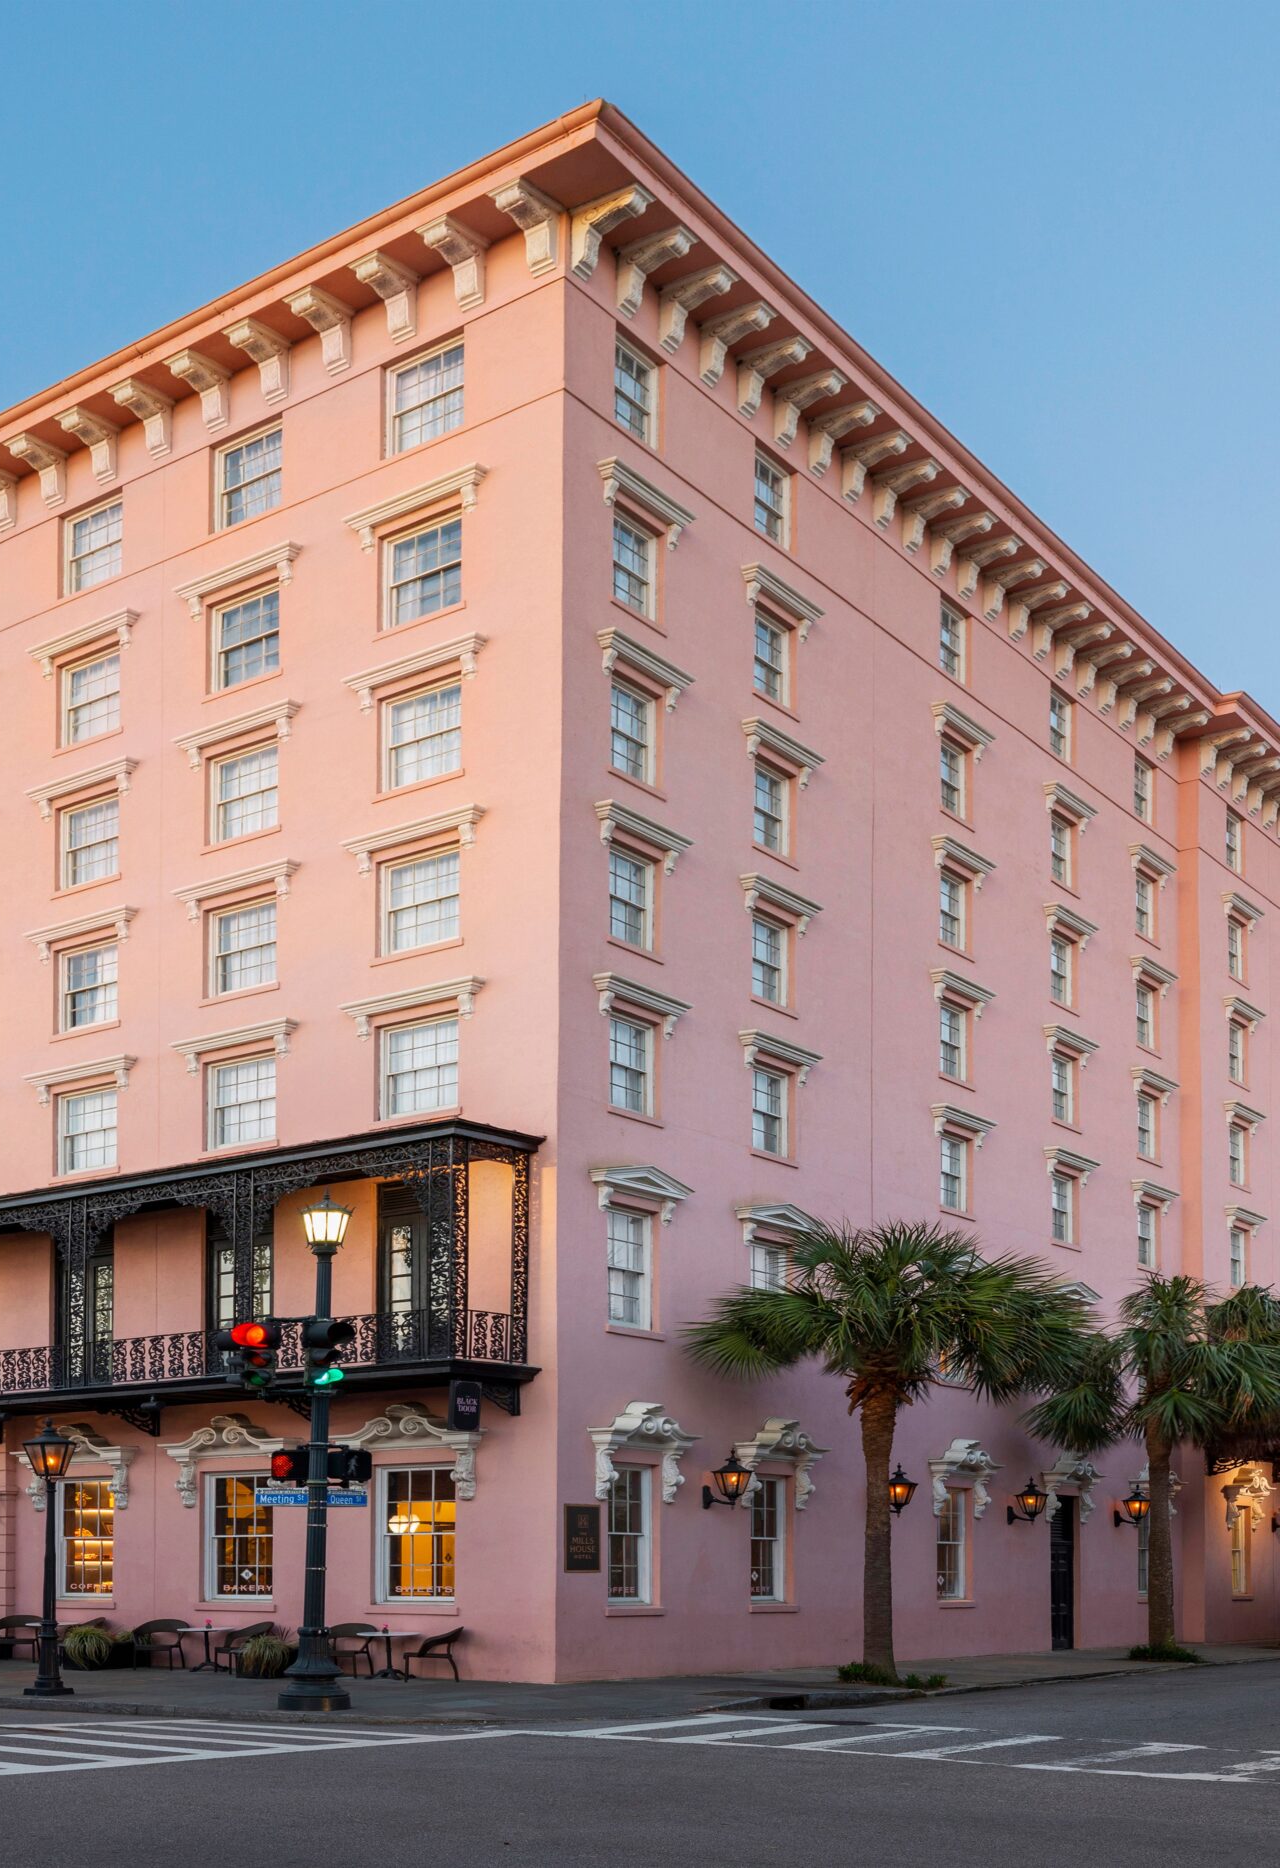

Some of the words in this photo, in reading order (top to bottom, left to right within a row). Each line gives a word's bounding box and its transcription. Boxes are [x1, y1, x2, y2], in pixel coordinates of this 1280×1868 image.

[456, 1397, 478, 1406] BLACK
[260, 1495, 295, 1505] Meeting
[330, 1495, 353, 1505] Queen
[571, 1537, 595, 1545] MILLS
[569, 1545, 597, 1553] HOUSE
[395, 1585, 453, 1593] SWEETS
